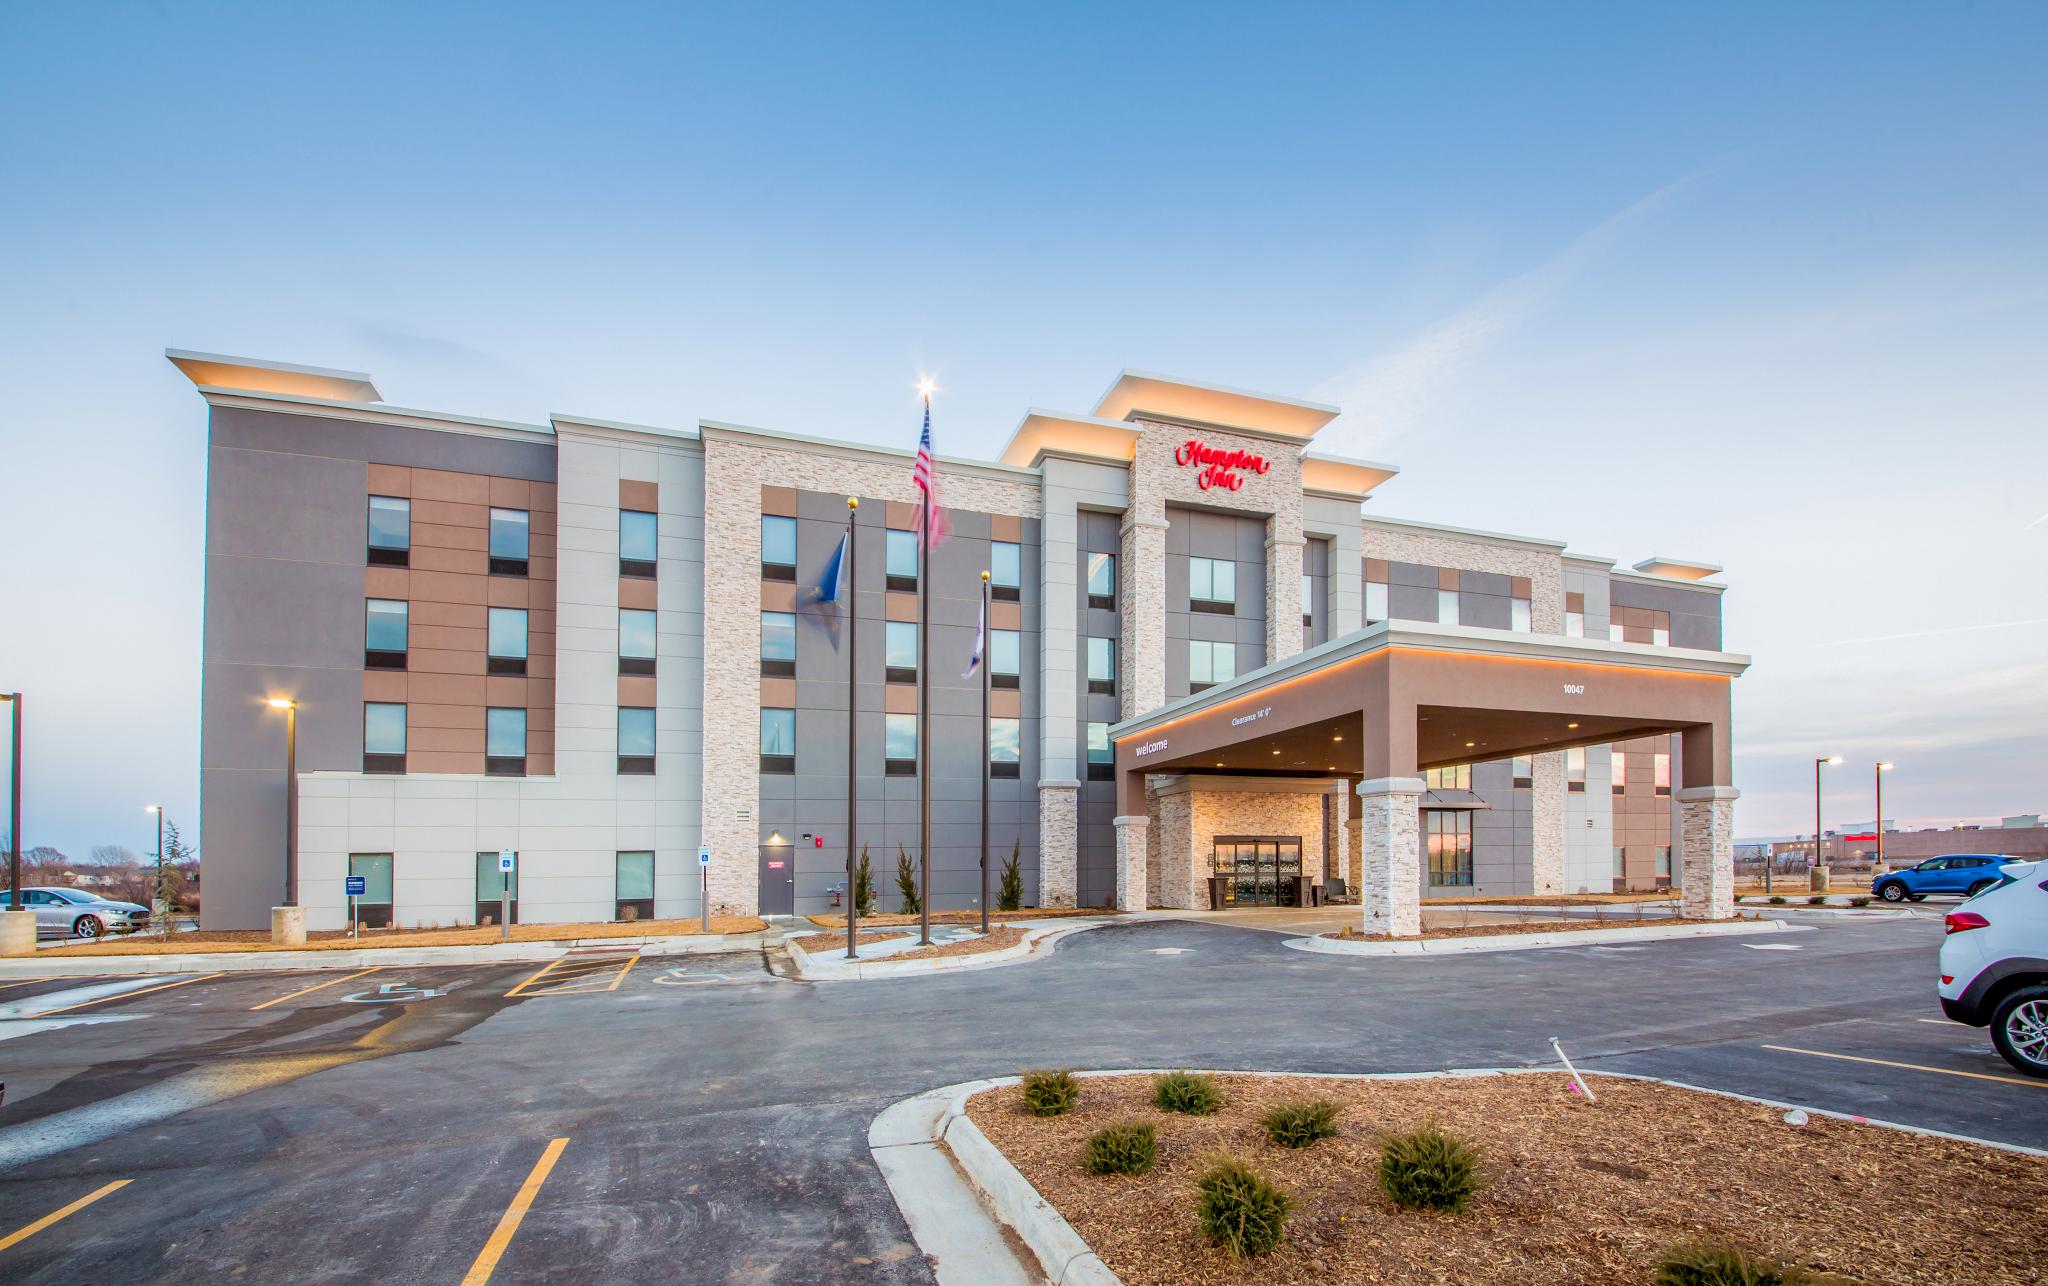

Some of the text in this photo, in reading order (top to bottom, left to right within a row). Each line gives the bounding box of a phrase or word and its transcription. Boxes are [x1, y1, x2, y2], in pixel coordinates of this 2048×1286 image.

[1176, 440, 1271, 474] Hampton
[1199, 464, 1244, 491] Inn
[1563, 684, 1584, 695] 10047
[1231, 713, 1257, 726] Clearance
[1135, 739, 1168, 757] welcome
